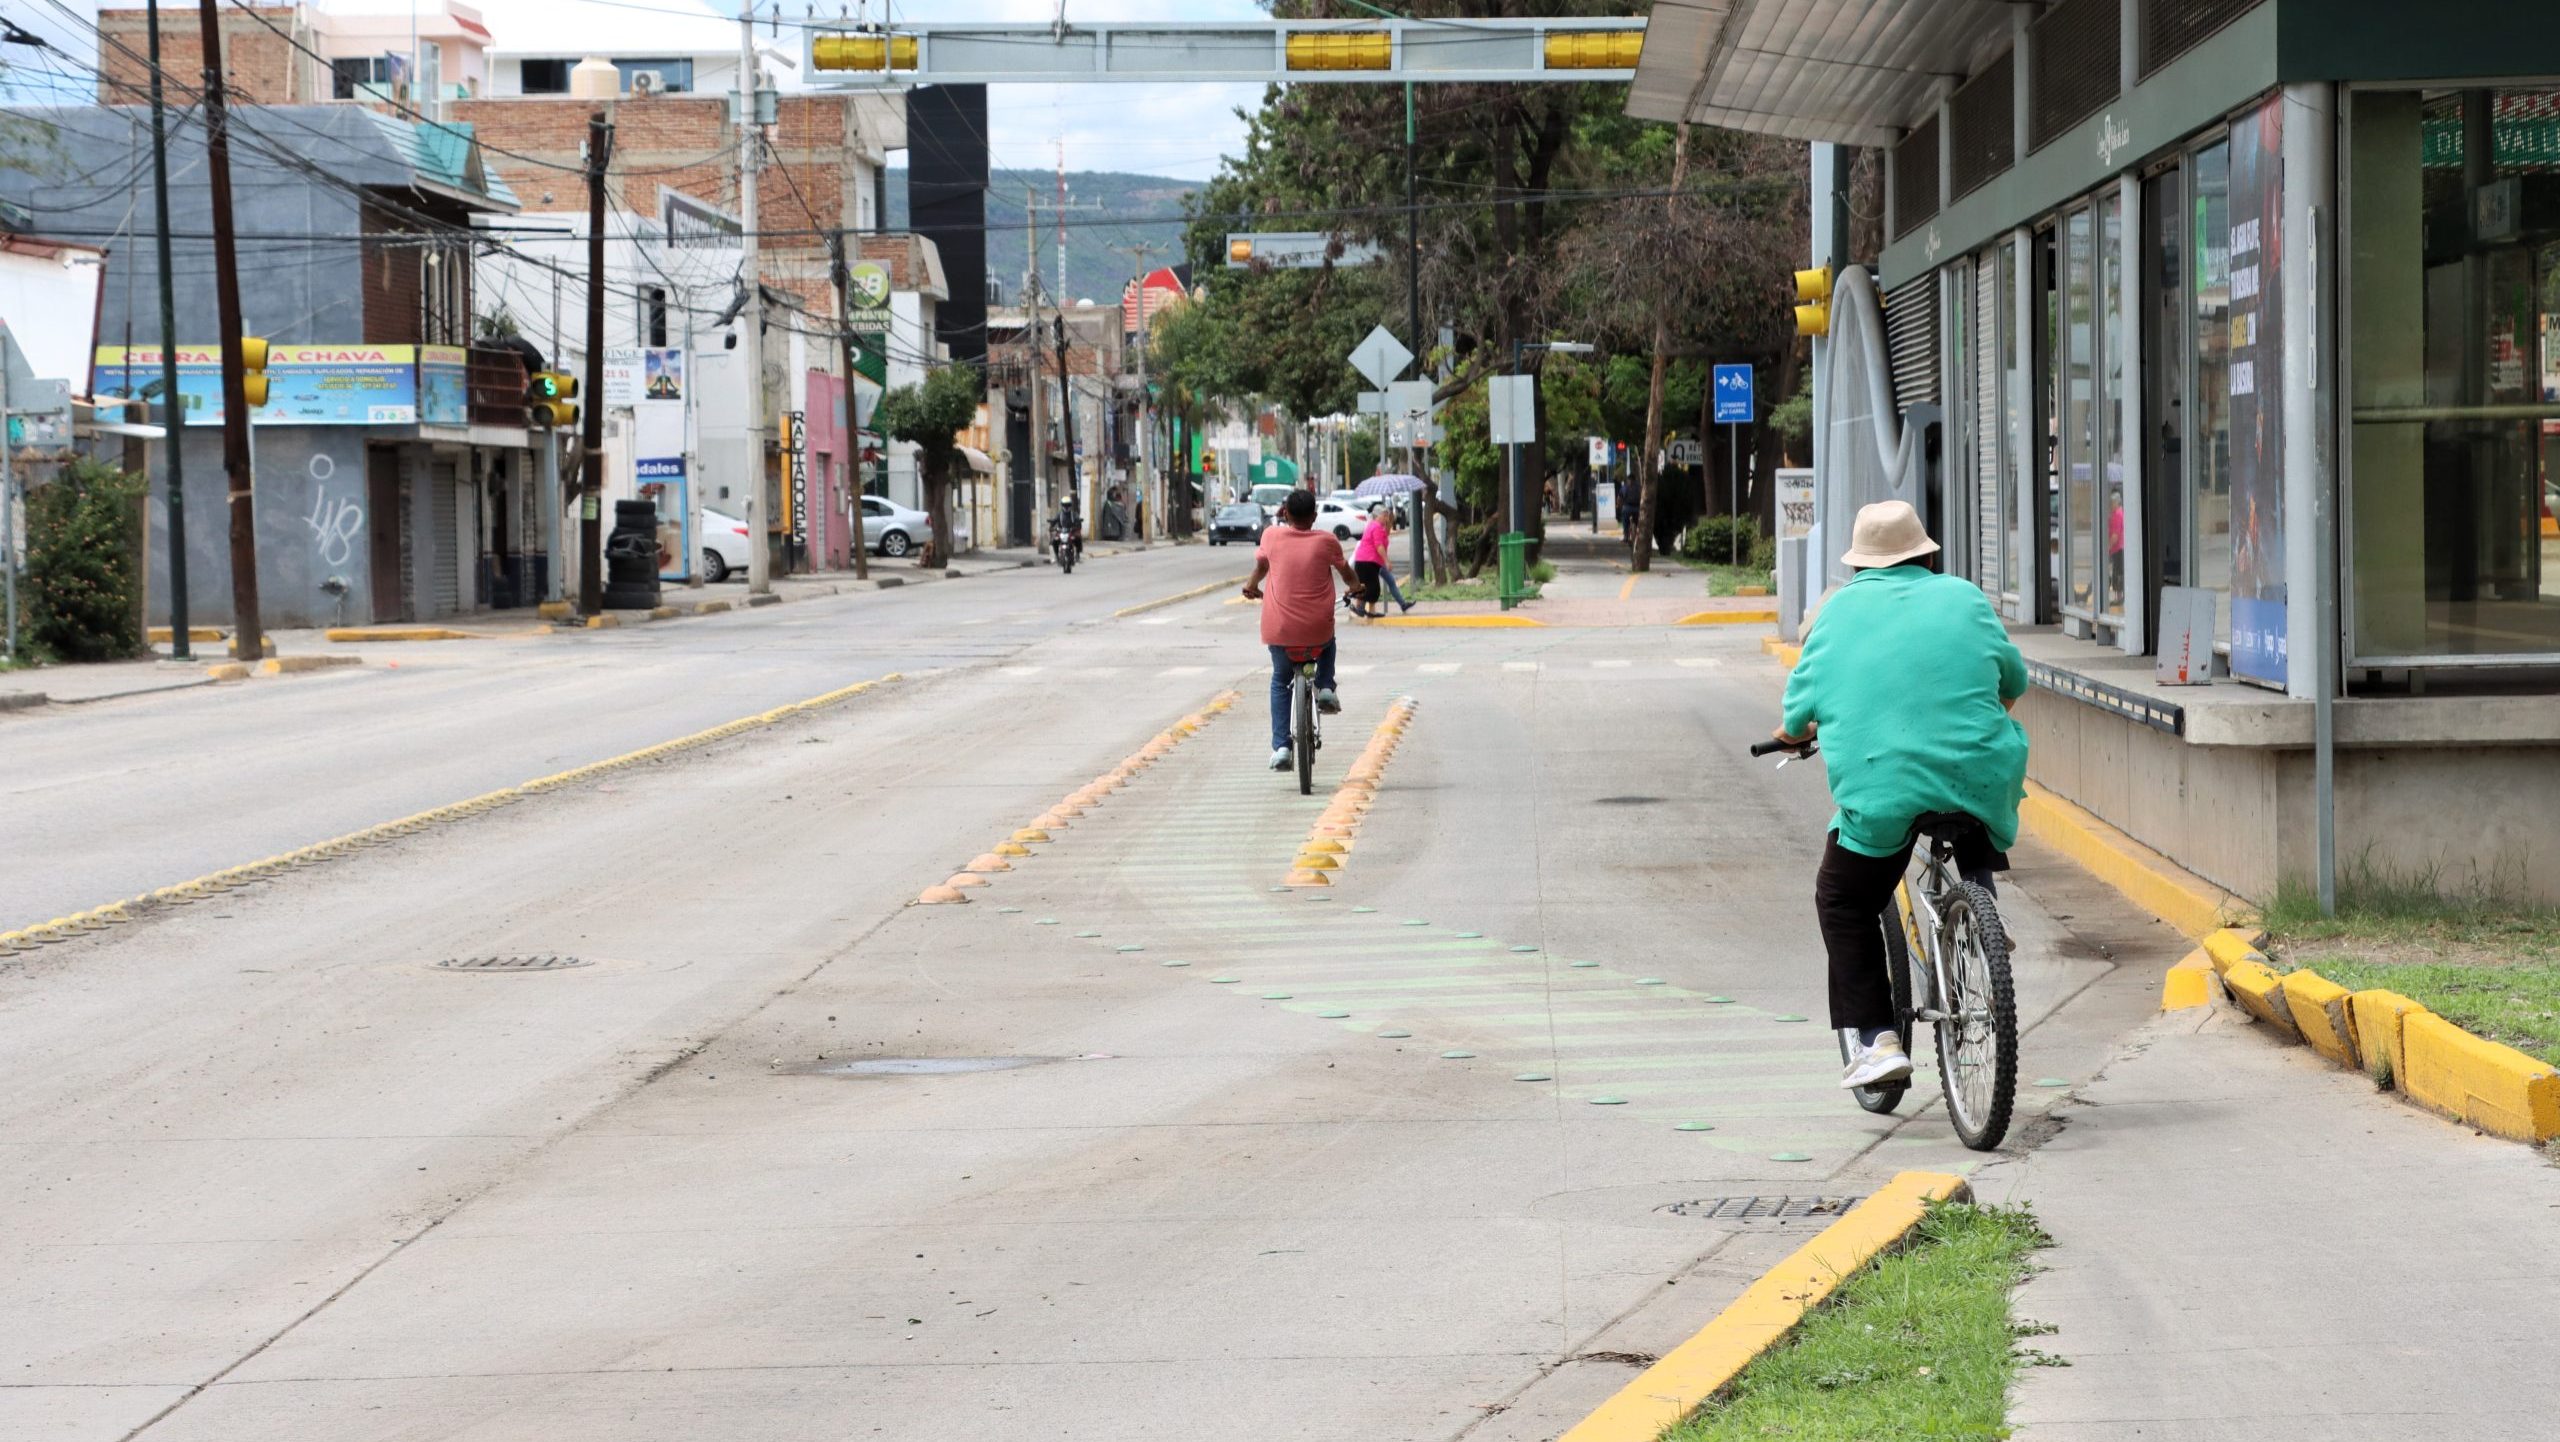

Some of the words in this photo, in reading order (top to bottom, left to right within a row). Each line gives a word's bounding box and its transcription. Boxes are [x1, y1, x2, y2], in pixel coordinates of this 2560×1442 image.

[2498, 127, 2560, 152] VALL
[848, 321, 891, 331] EBIDAS
[296, 351, 387, 362] CHAVA
